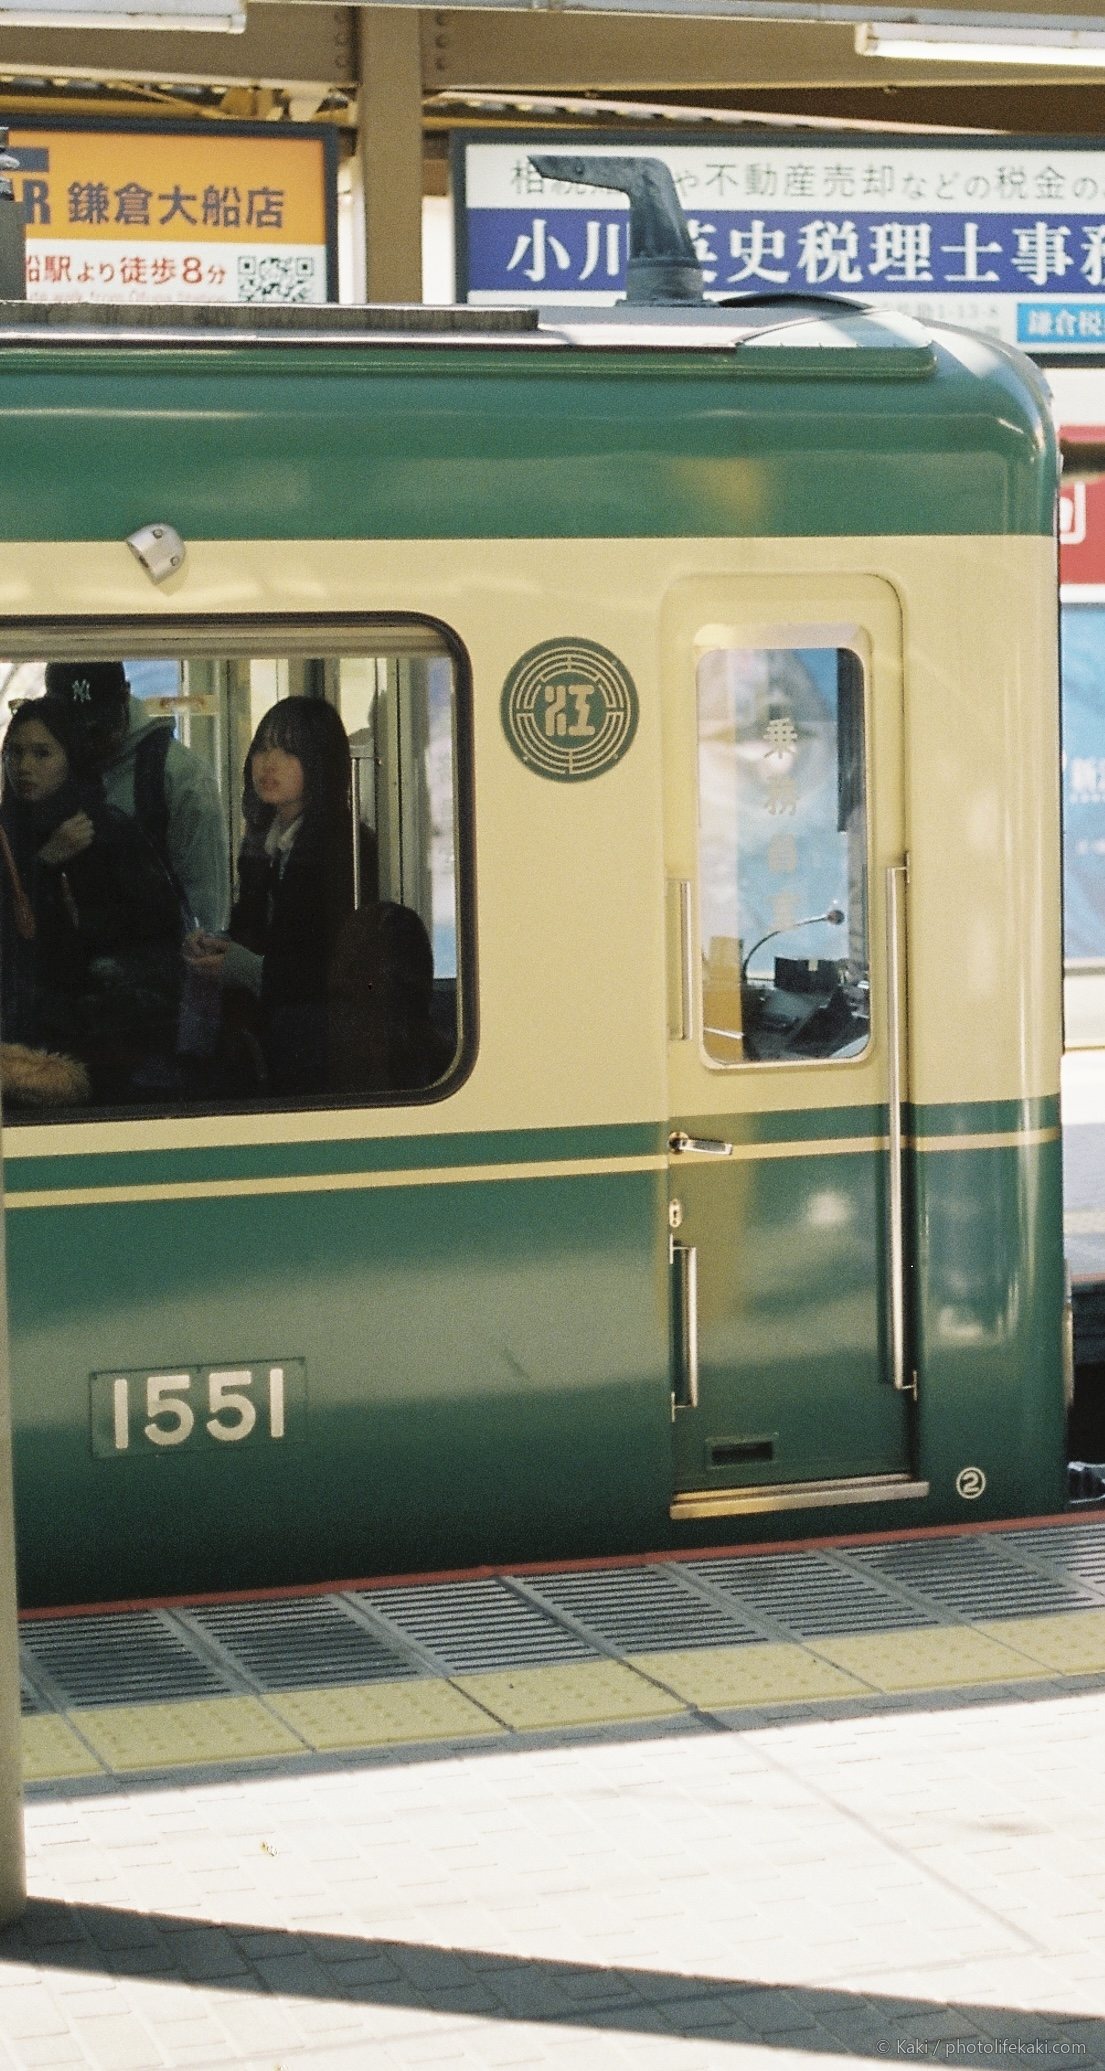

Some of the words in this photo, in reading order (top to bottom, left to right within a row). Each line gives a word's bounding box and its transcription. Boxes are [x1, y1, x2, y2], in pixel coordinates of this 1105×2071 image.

[67, 181, 285, 229] 鎌倉大船店
[114, 1368, 284, 1449] 1551
